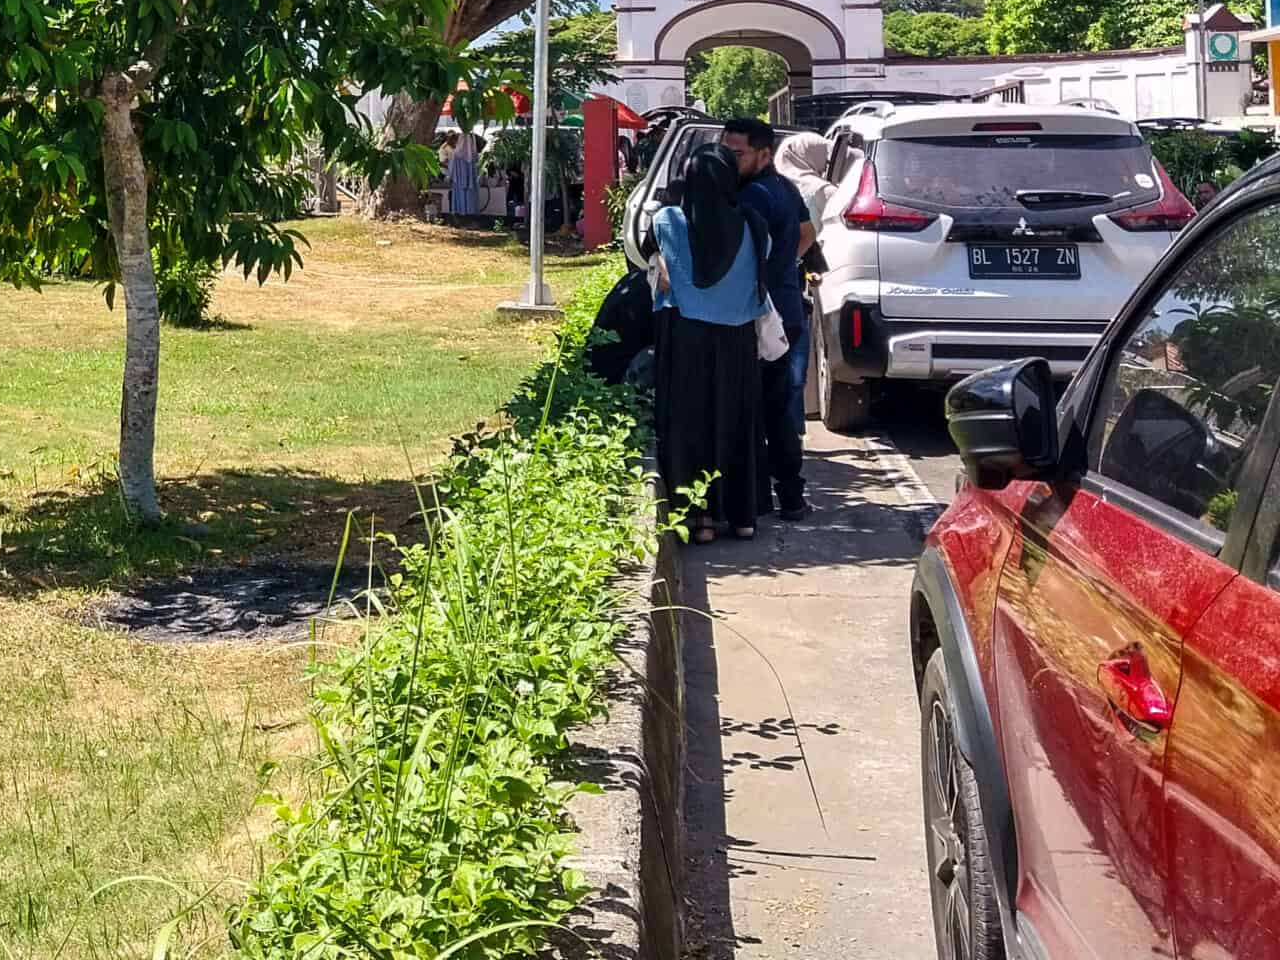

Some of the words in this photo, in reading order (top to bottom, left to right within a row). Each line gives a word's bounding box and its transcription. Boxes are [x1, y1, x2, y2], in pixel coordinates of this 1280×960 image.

[972, 248, 992, 265] BL
[1005, 248, 1040, 265] 1527
[1055, 248, 1075, 265] ZN
